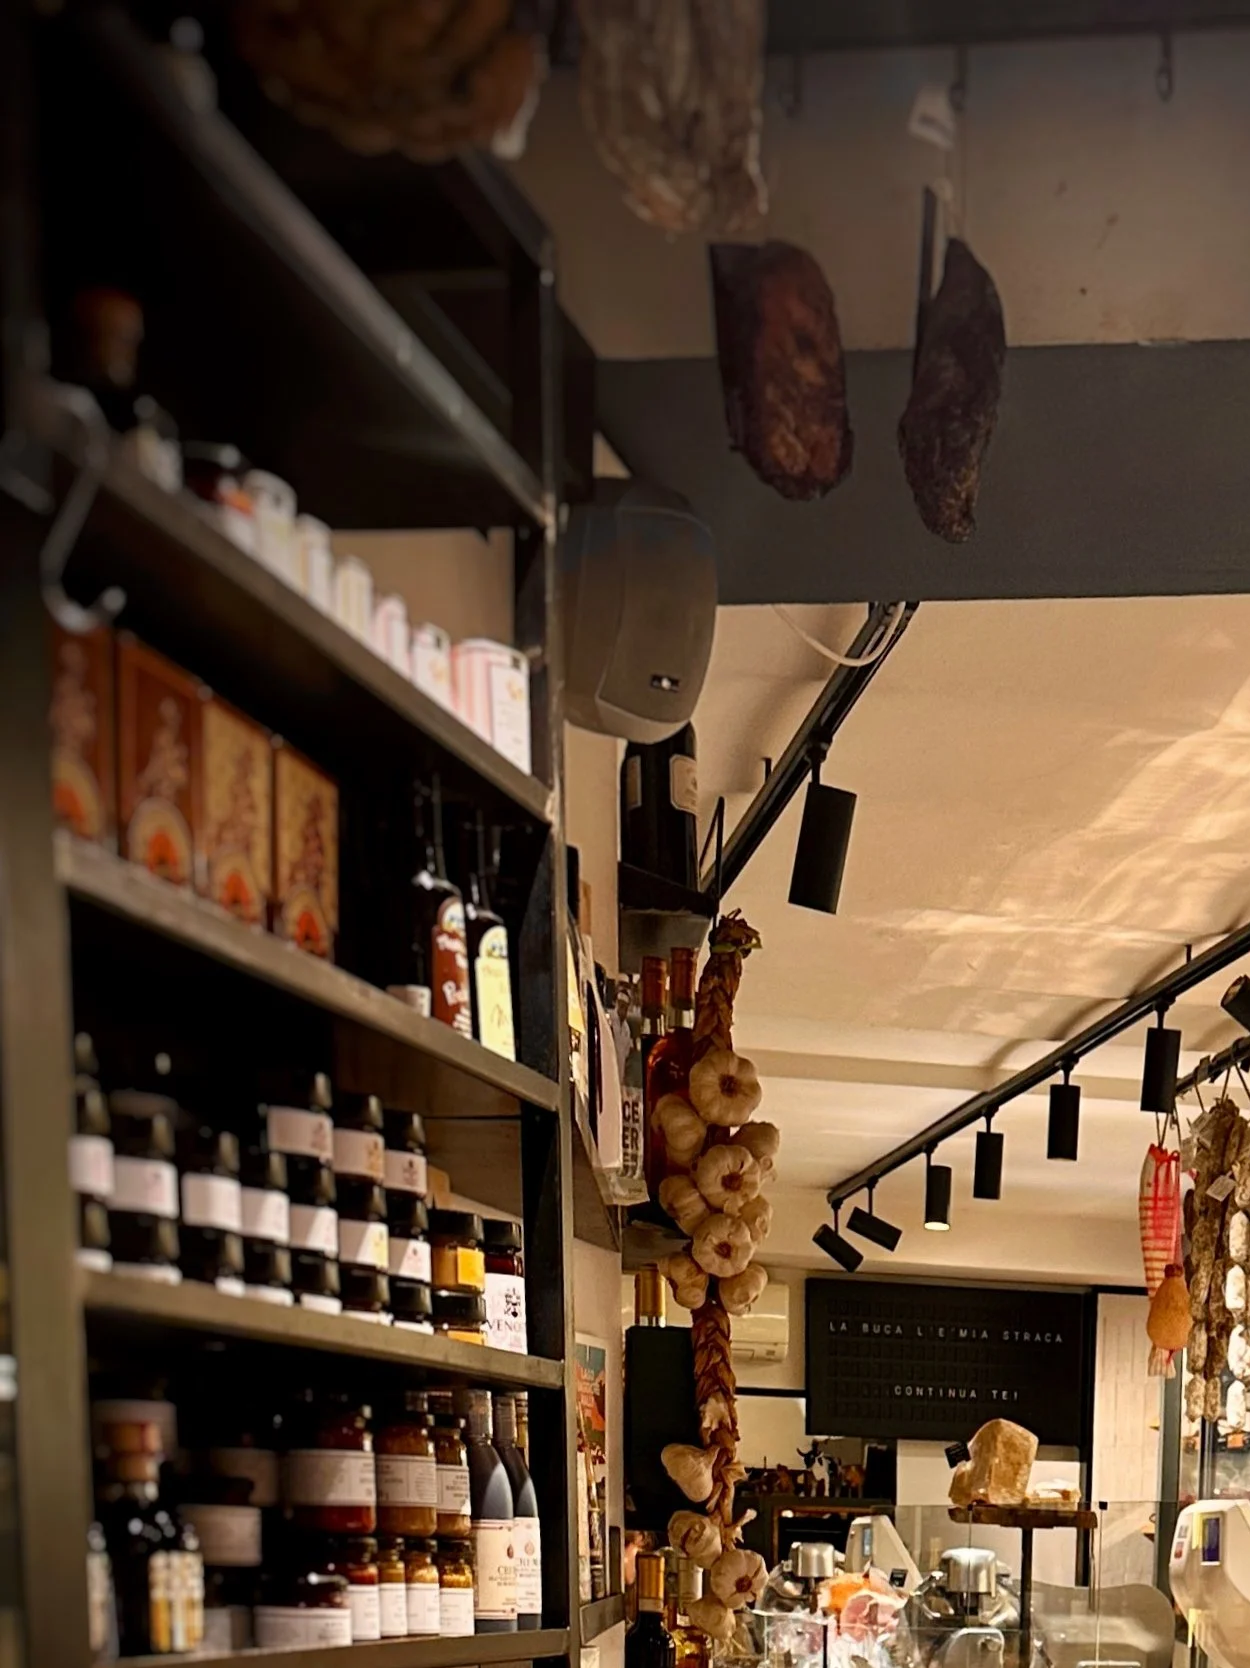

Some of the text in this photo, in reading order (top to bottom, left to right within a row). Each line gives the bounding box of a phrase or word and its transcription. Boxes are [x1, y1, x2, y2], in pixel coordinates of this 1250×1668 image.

[829, 1321, 848, 1333] LA
[862, 1323, 902, 1335] BUCA
[1002, 1330, 1063, 1343] STRACA
[894, 1385, 977, 1399] CONTINUA
